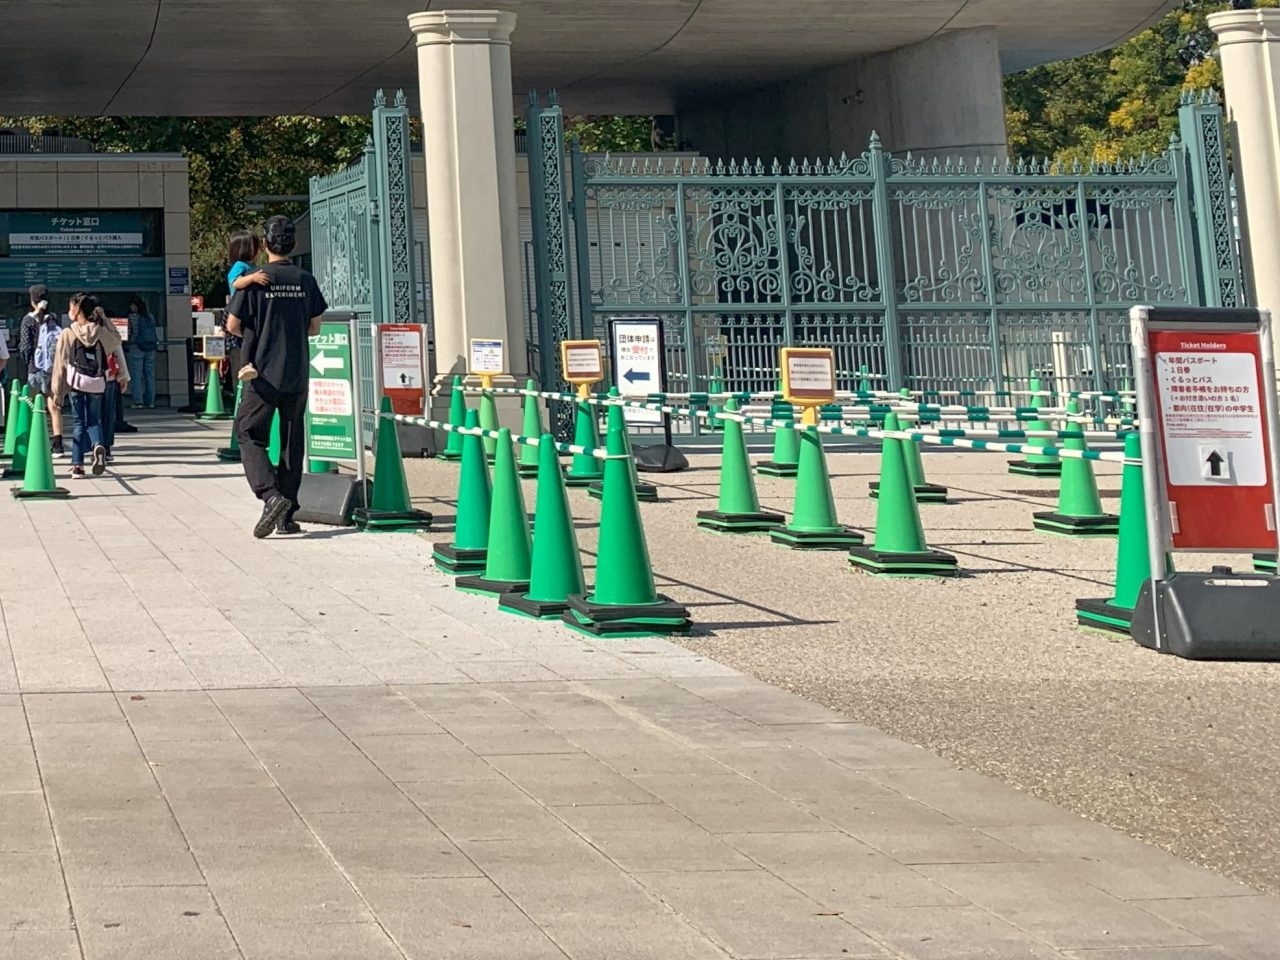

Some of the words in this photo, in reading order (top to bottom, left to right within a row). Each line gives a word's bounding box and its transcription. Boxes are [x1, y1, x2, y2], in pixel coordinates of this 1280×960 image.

[50, 217, 100, 226] チケット窓口
